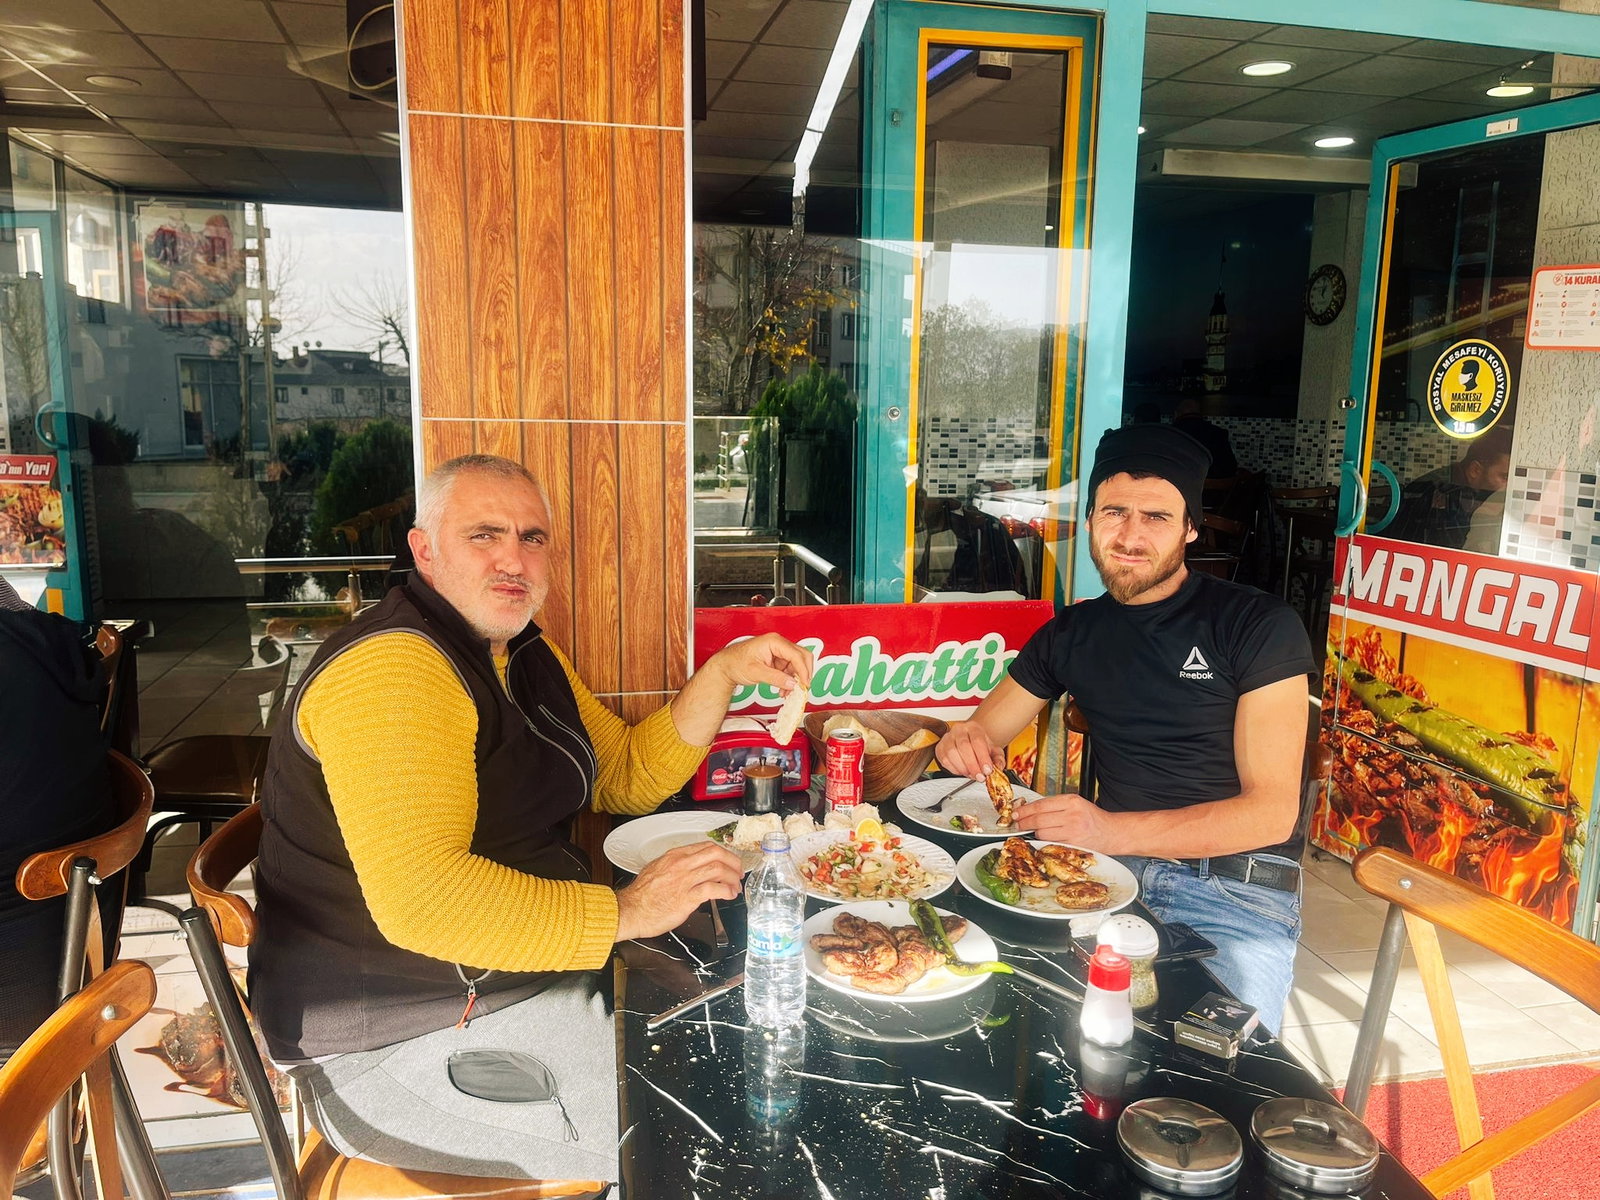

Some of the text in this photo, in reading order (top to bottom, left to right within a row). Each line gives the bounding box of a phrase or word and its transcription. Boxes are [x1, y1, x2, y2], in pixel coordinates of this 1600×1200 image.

[1564, 276, 1573, 286] 14
[1432, 371, 1445, 411] SOSYAL
[1442, 346, 1487, 370] MESAFEYİ
[25, 461, 51, 476] Yeri
[1340, 543, 1590, 653] MANGAL
[1179, 670, 1214, 680] Reebok
